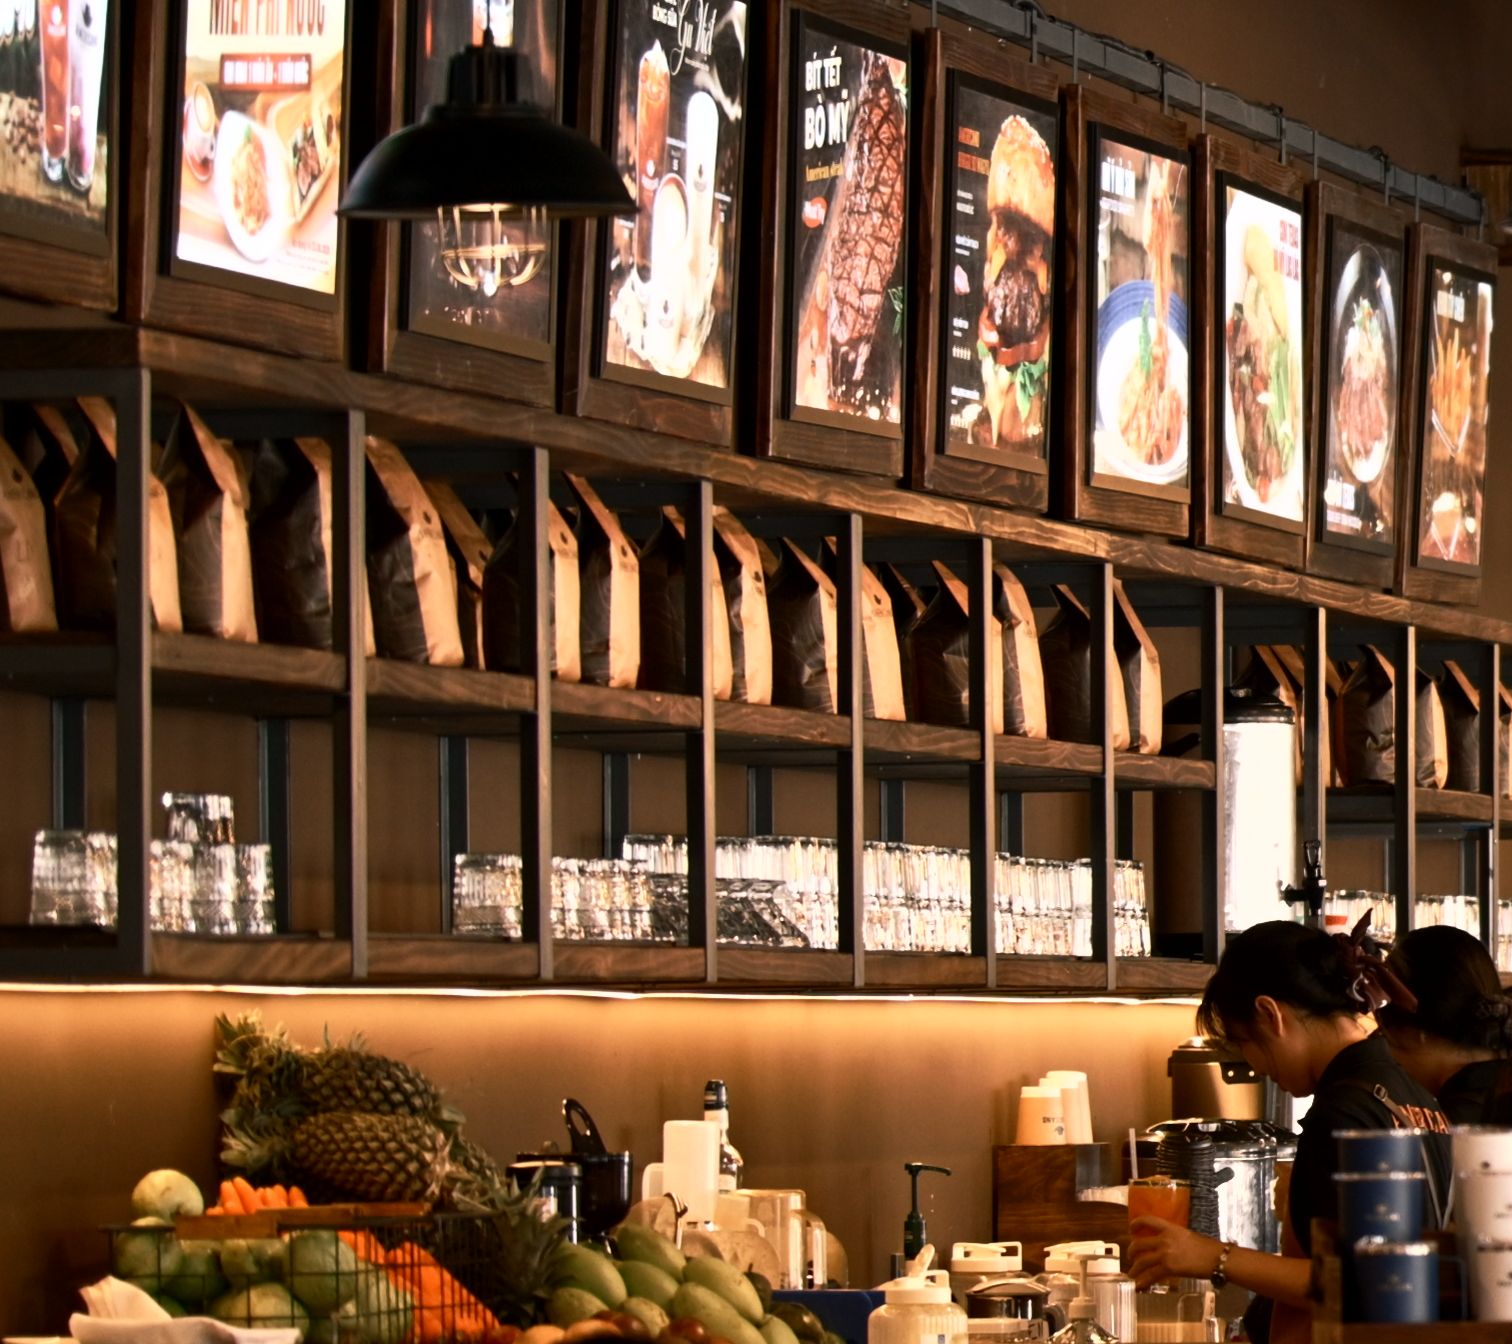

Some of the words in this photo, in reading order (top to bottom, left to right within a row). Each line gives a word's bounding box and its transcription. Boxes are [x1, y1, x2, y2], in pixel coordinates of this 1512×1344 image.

[805, 52, 823, 92] BÍT
[823, 45, 842, 89] TẾT
[804, 93, 826, 150] BÒ
